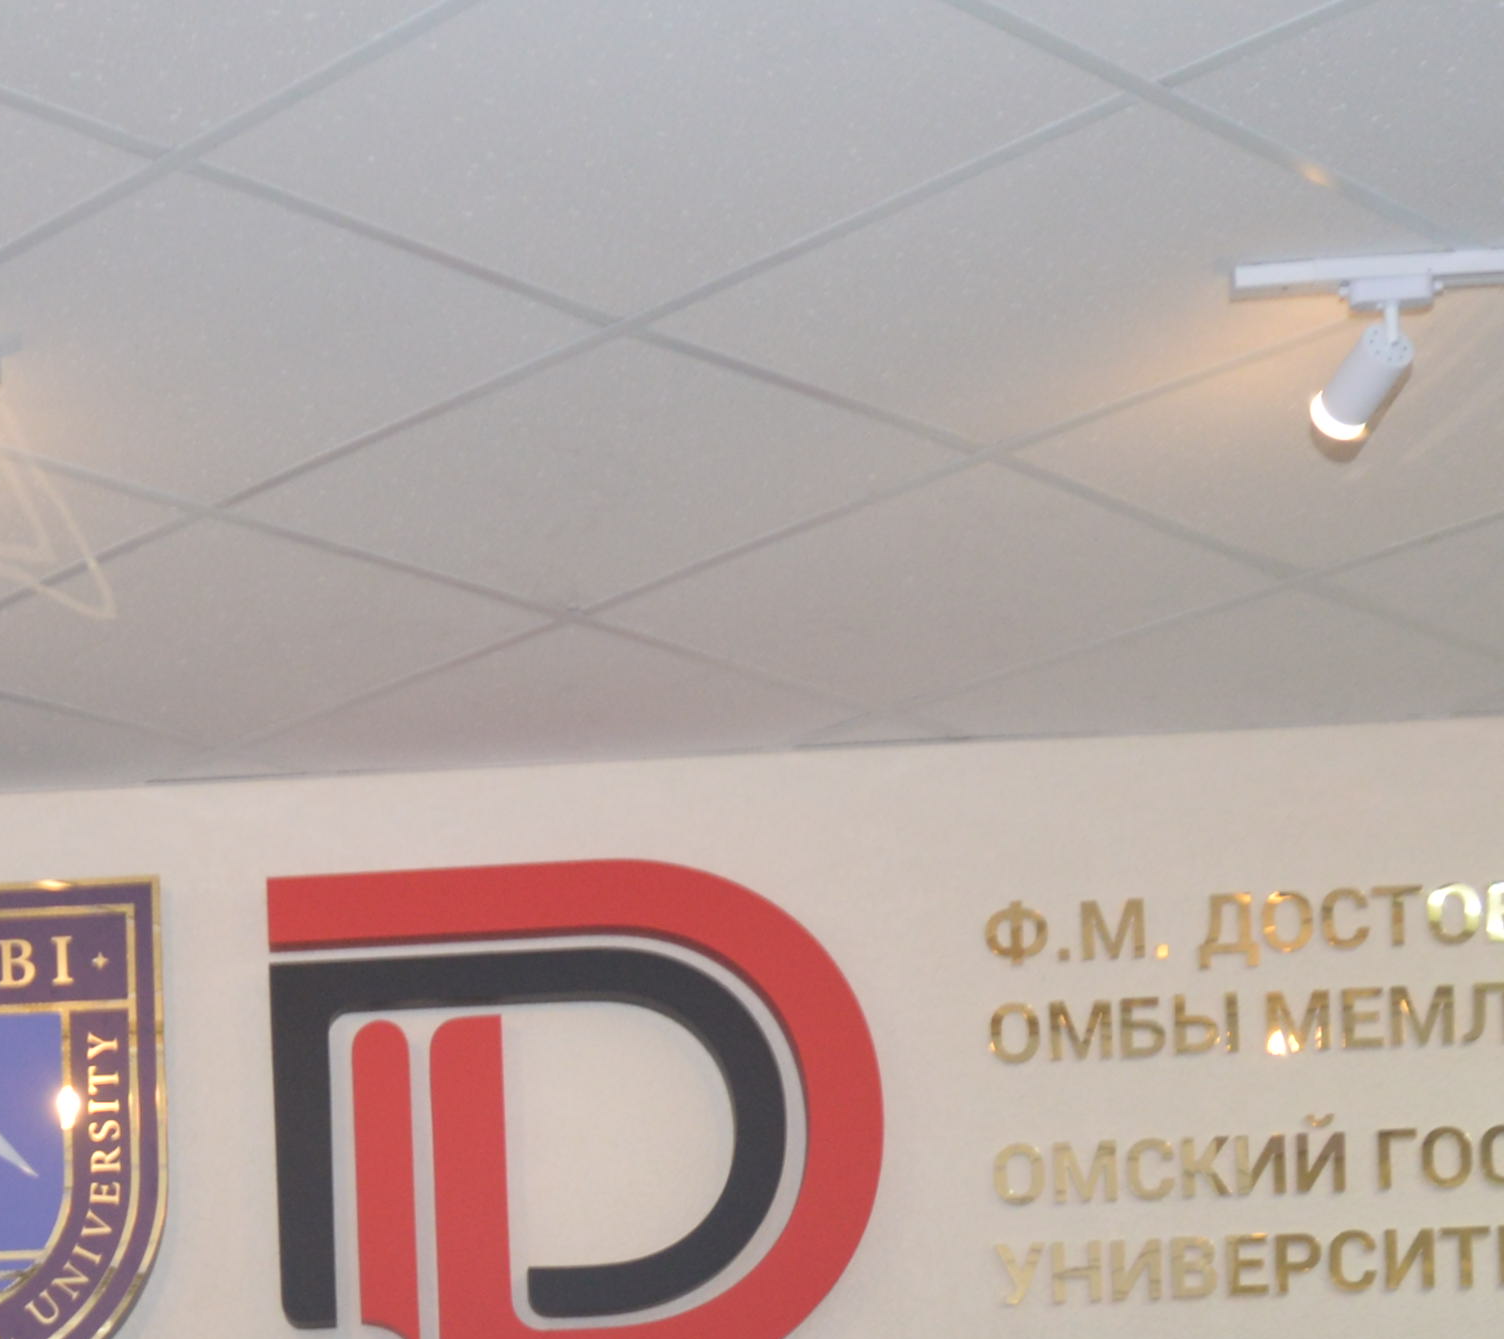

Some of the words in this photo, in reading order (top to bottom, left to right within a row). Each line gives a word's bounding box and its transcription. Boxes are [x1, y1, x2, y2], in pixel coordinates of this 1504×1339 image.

[984, 898, 1170, 966] Ф.М.
[989, 991, 1241, 1065] ОМБЫ
[24, 1032, 122, 1327] UNIVERSITY
[994, 1112, 1348, 1206] ОМСКИЙ
